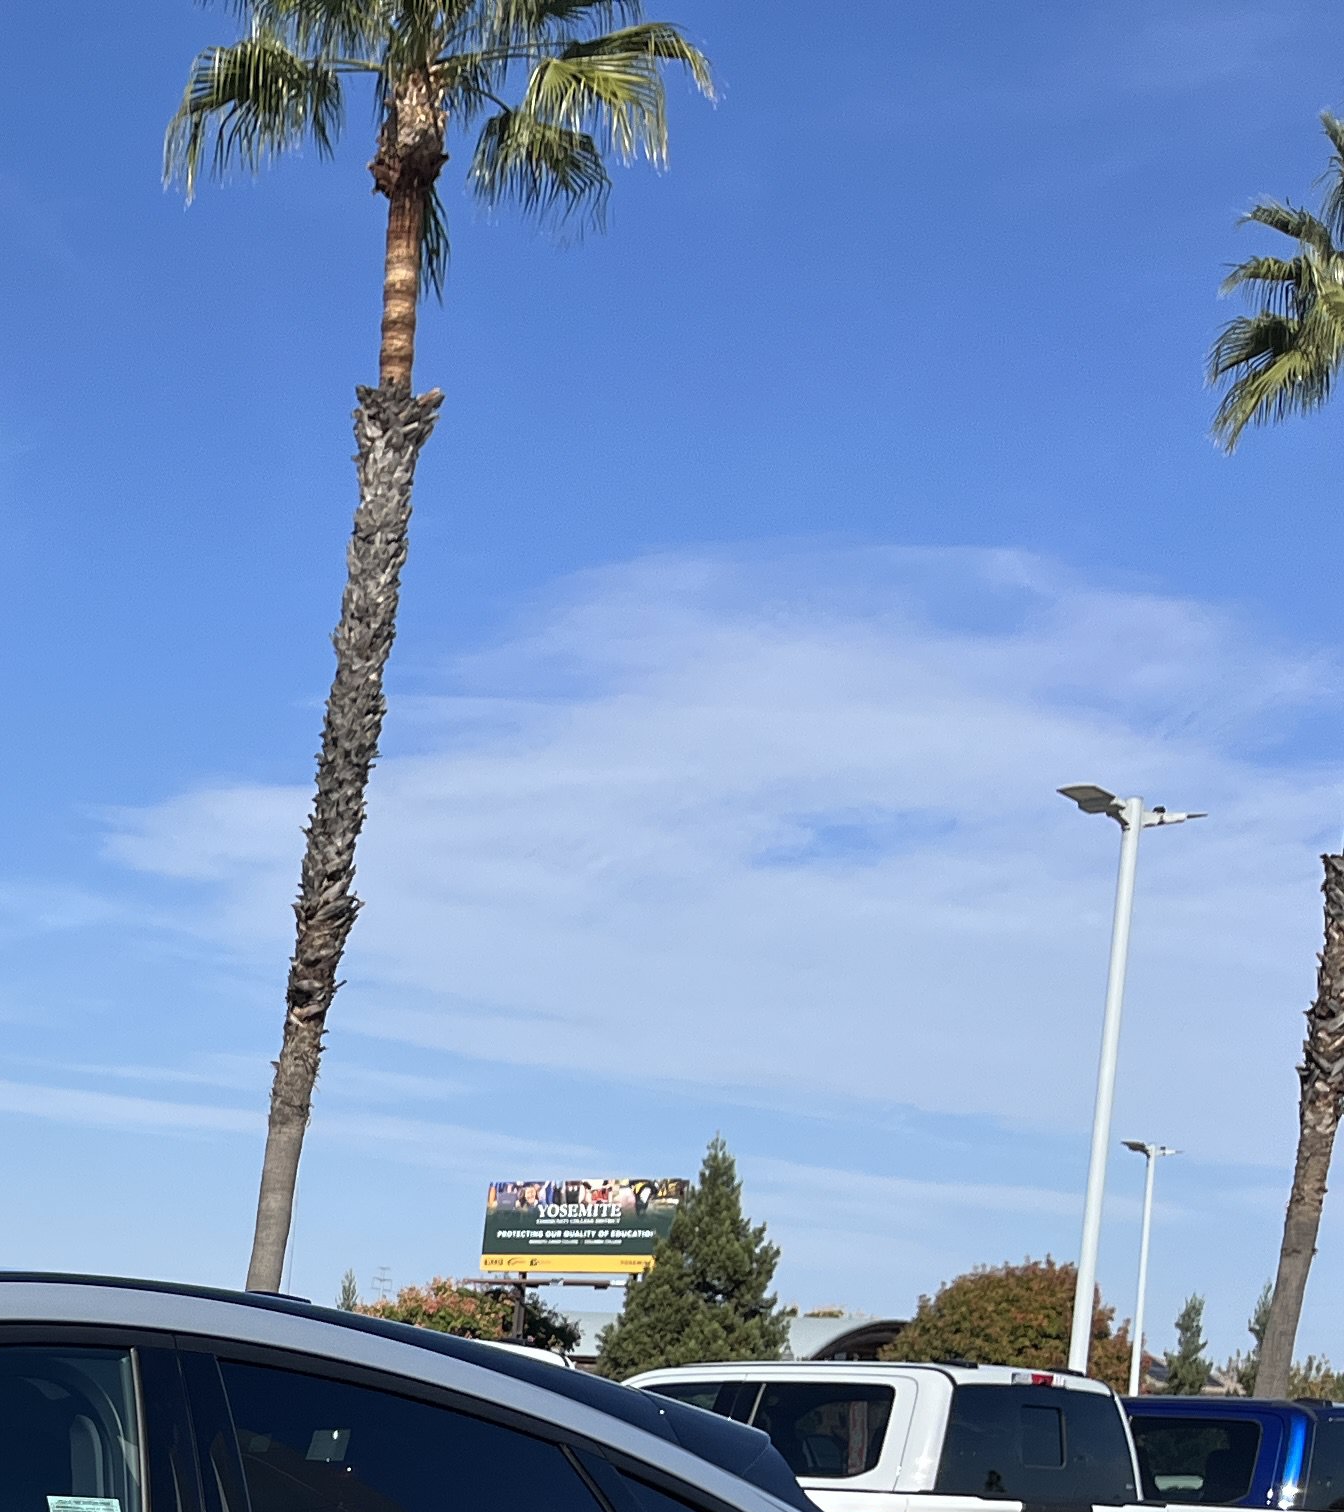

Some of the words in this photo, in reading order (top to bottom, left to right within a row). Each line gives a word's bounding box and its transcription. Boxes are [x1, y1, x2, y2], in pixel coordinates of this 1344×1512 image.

[537, 1203, 622, 1218] YOSEMITE
[497, 1230, 543, 1238] PROTECTING
[545, 1230, 562, 1238] OUR
[563, 1229, 596, 1238] QUALITY
[598, 1229, 609, 1238] OF
